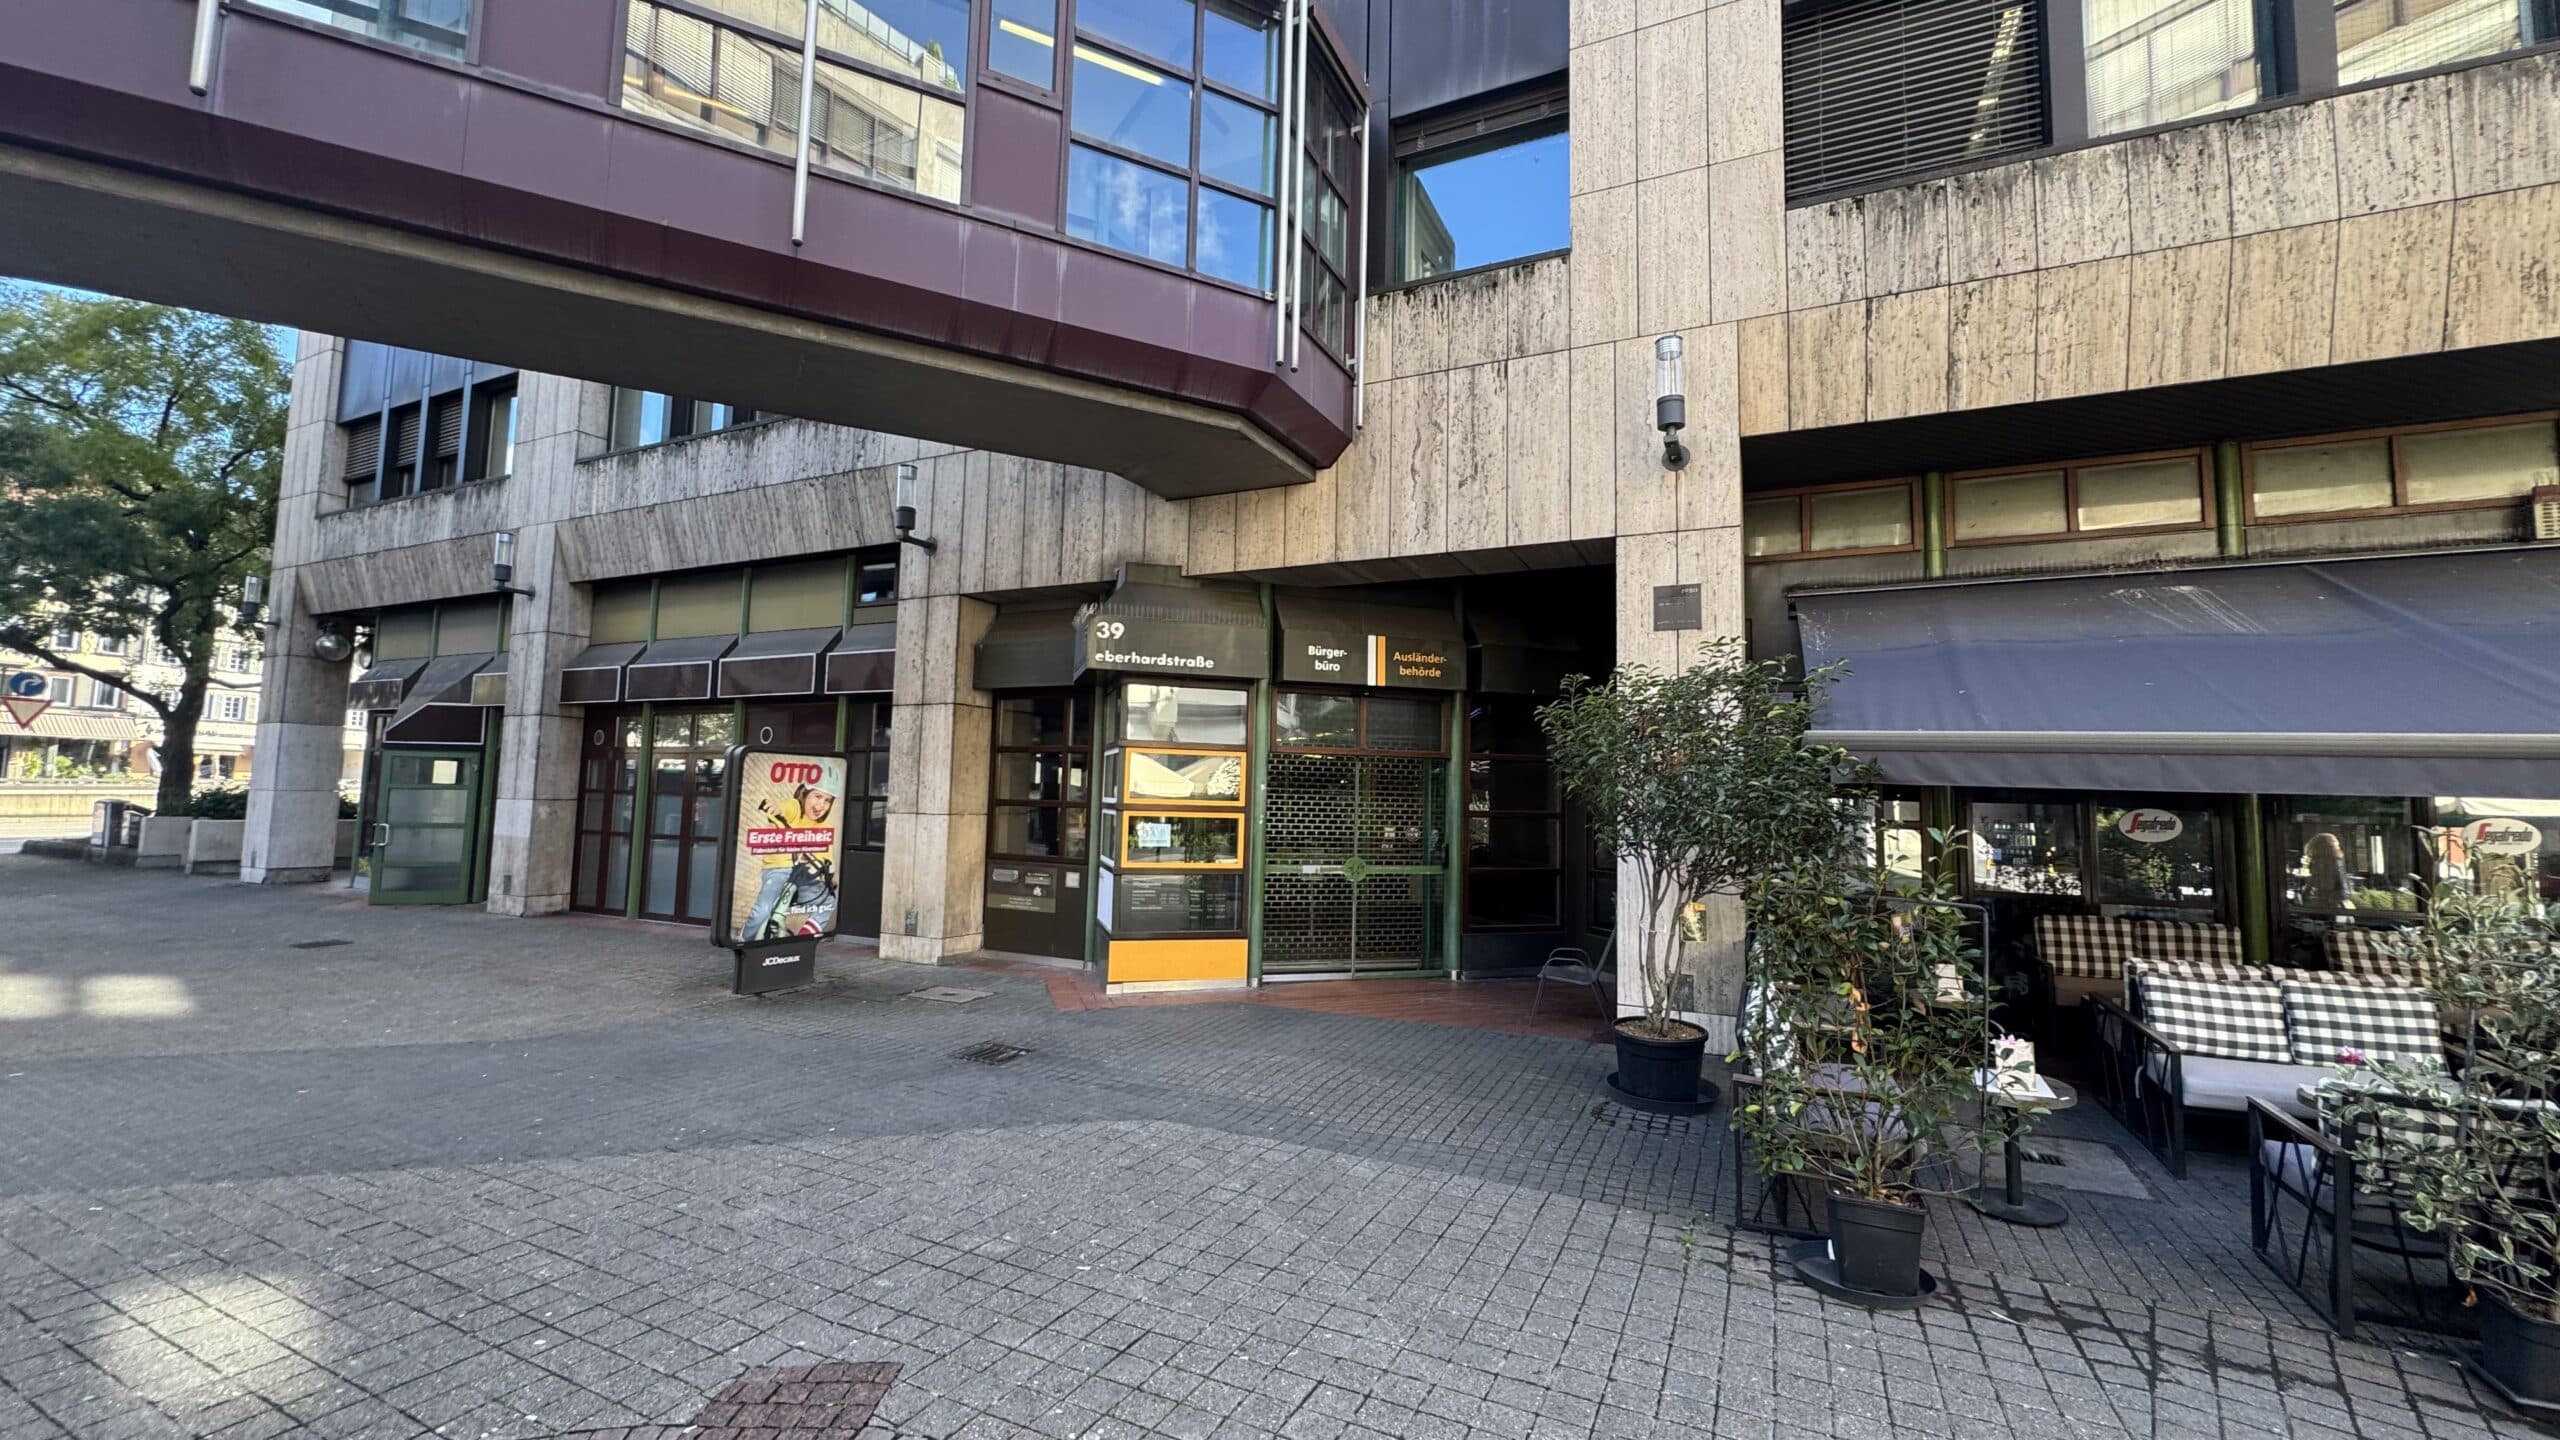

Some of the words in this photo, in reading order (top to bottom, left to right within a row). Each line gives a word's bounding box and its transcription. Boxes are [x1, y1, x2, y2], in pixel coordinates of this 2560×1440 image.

[1096, 621, 1125, 640] 39
[1308, 645, 1348, 659] Bürger-
[1393, 651, 1448, 664] Ausländer-
[1094, 650, 1215, 669] eberhardstraße
[1315, 660, 1341, 671] büro
[1400, 665, 1442, 678] behörde
[770, 762, 823, 784] OTTO
[749, 831, 783, 844] Erste
[784, 830, 832, 843] Freiheit
